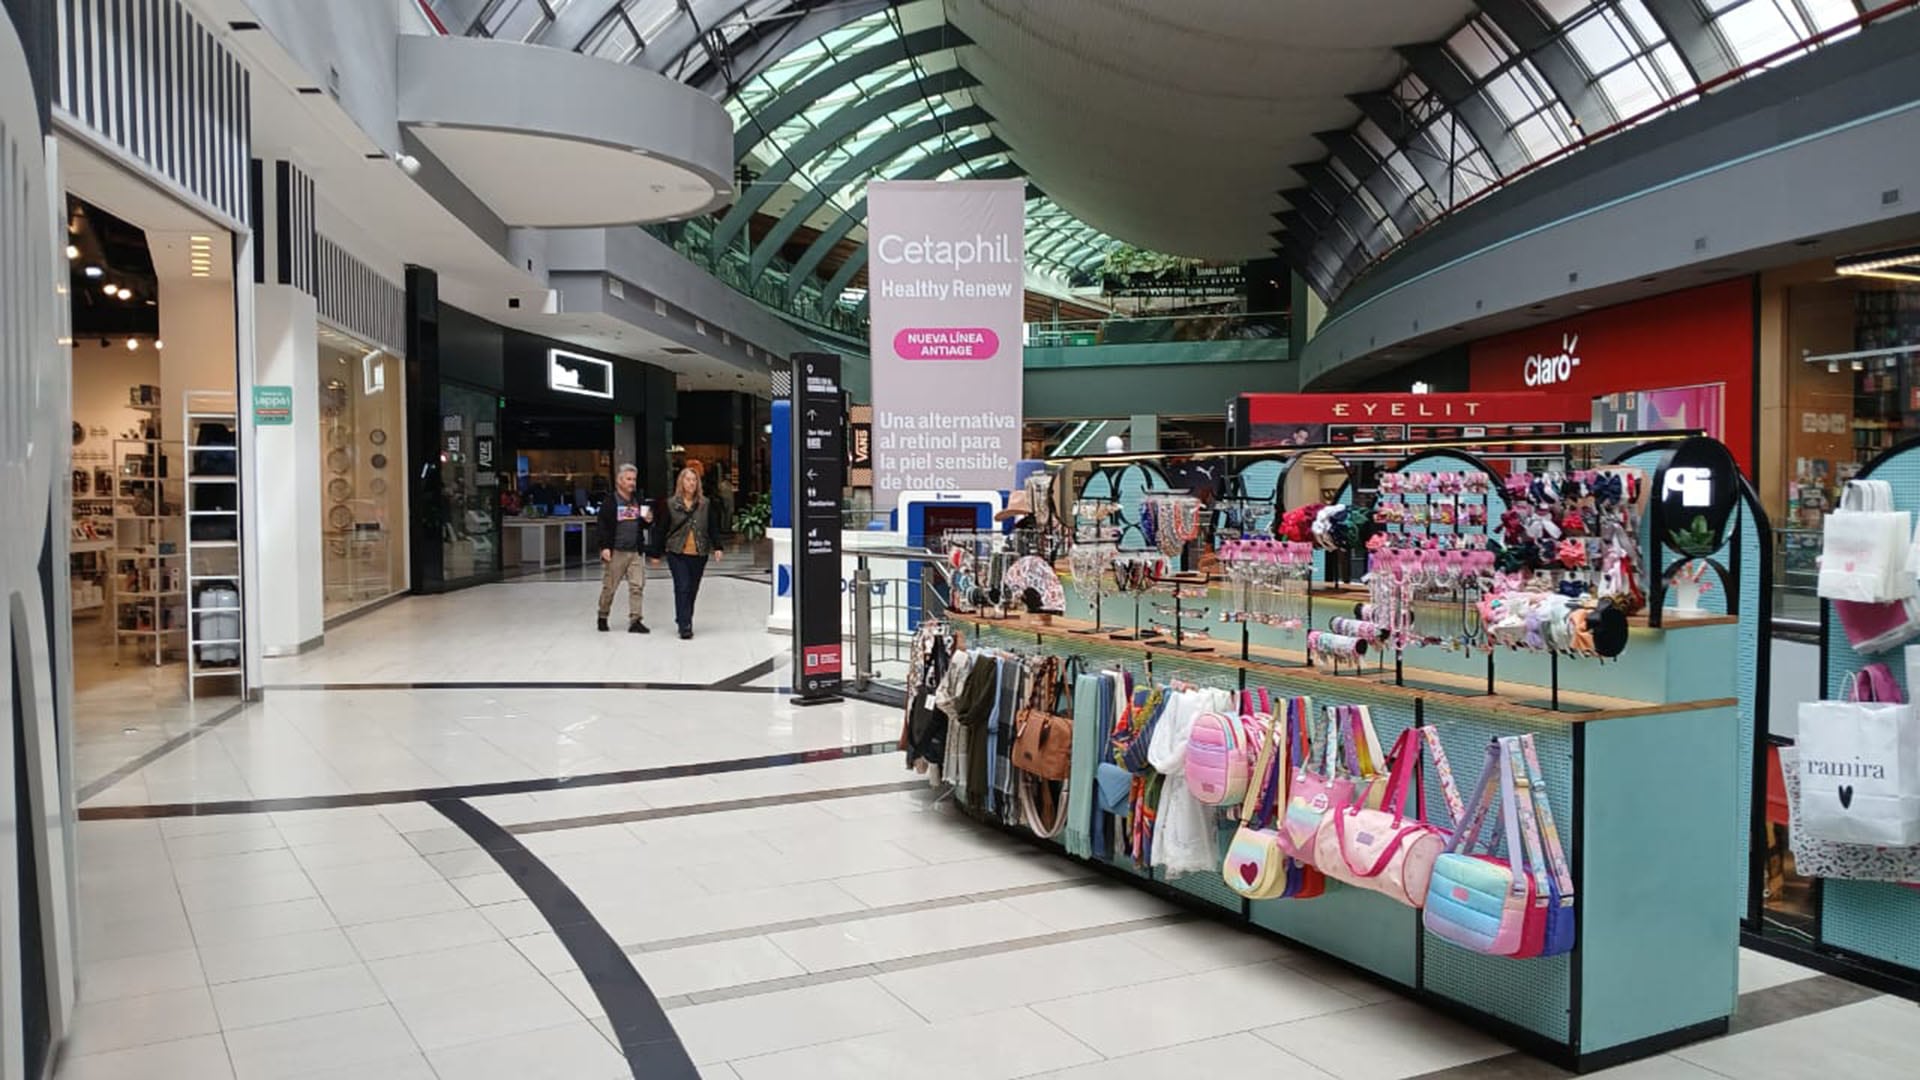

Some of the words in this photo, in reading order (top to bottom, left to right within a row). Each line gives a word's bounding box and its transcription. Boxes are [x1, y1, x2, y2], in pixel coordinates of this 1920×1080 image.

[881, 279, 949, 300] Healthy
[953, 279, 1012, 297] Renew
[907, 333, 949, 344] NUEVA
[950, 331, 984, 344] LÍNEA
[921, 346, 973, 356] ANTIAGE
[1524, 353, 1573, 387] Claro
[1332, 403, 1480, 416] EYELIT
[879, 412, 915, 429] Una
[919, 411, 1015, 429] alternativa
[855, 429, 869, 463] VANS
[880, 432, 896, 449] al
[900, 432, 957, 449] retinol
[961, 435, 1001, 453] para
[880, 454, 898, 469] la
[900, 453, 931, 473] piel
[935, 453, 1013, 473] sensible,
[881, 473, 901, 490] de
[904, 474, 960, 490] todos.
[1806, 756, 1885, 780] ramira
